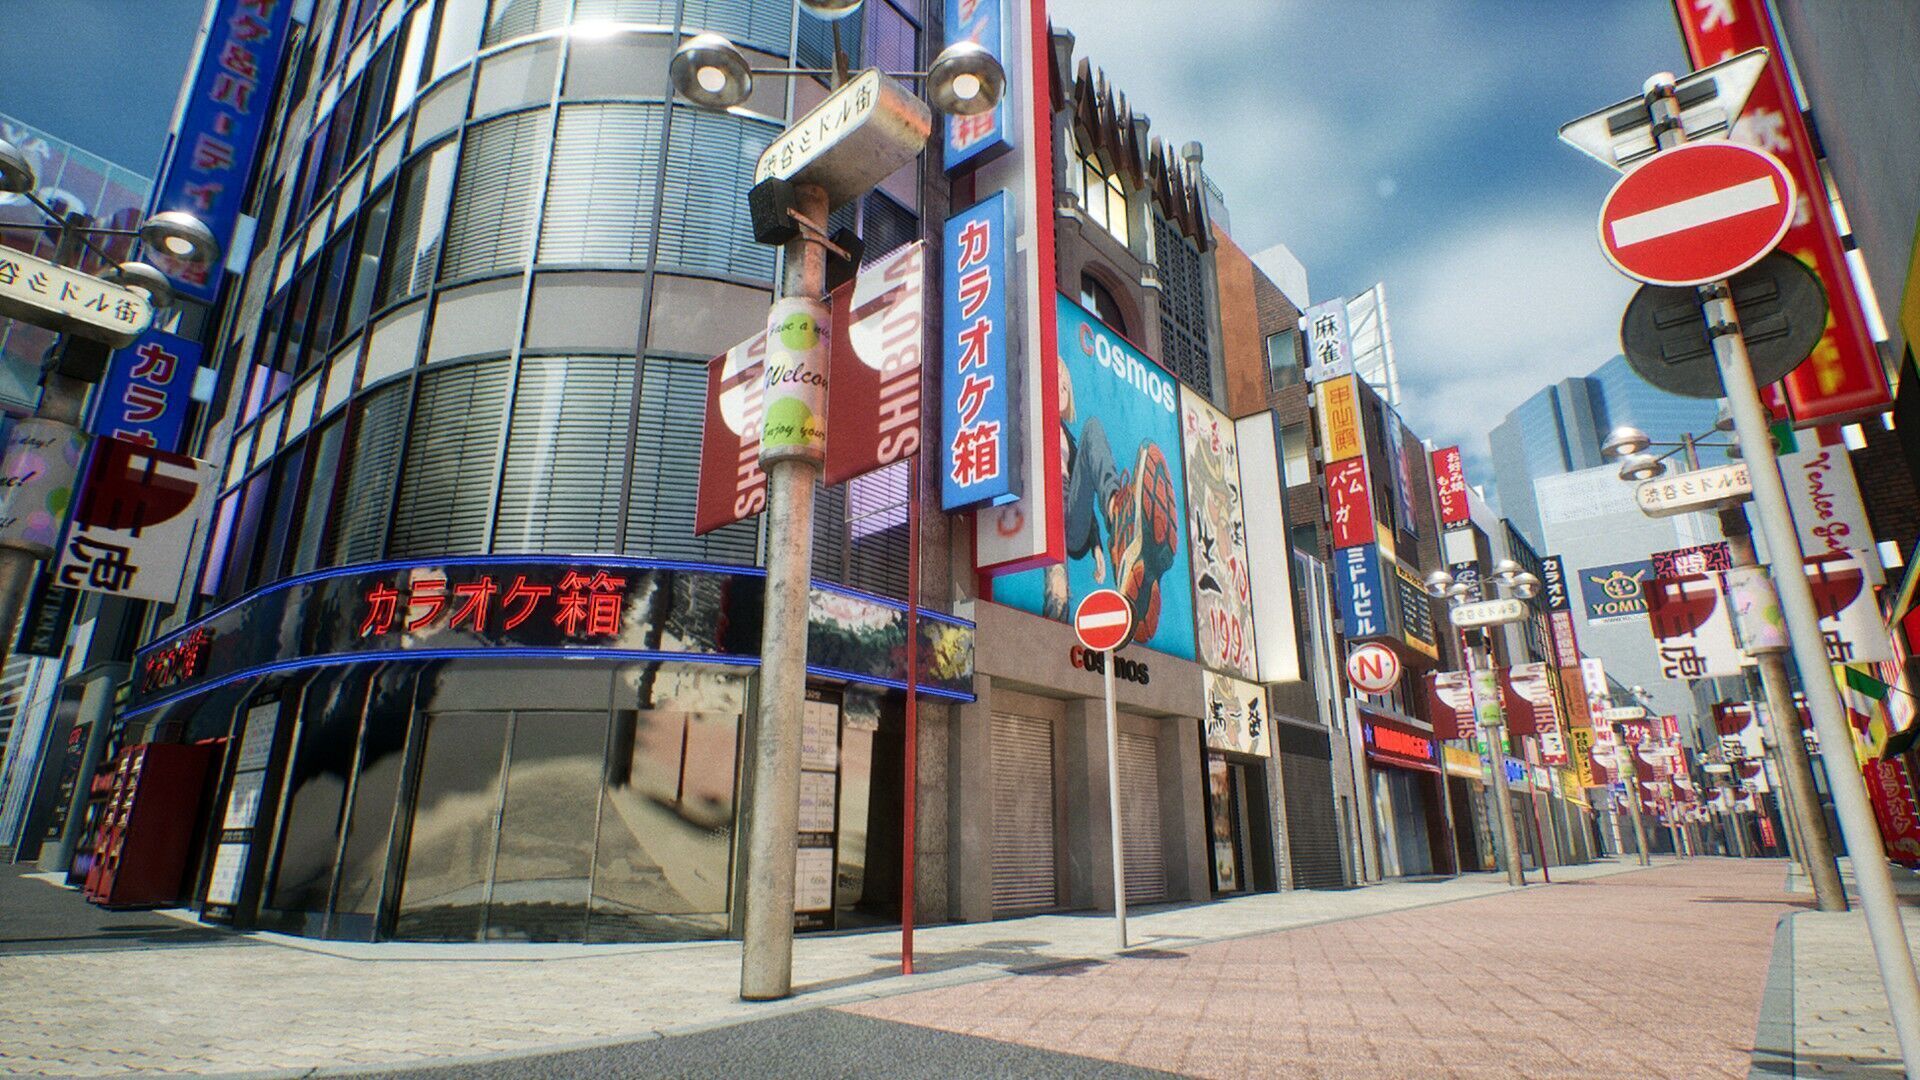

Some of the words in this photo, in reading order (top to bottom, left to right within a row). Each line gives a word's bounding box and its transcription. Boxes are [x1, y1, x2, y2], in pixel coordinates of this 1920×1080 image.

[763, 80, 872, 177] 渋谷ミドル街
[877, 243, 921, 466] SHIBUYA
[951, 218, 1001, 489] カラオケ箱
[1078, 321, 1177, 415] cosmos
[1314, 313, 1342, 366] 麻雀
[1330, 469, 1351, 540] バーガー
[358, 567, 627, 637] カラオケ箱
[1346, 546, 1377, 637] ミドルビル
[1542, 558, 1566, 608] カラオケ
[1357, 653, 1383, 681] N
